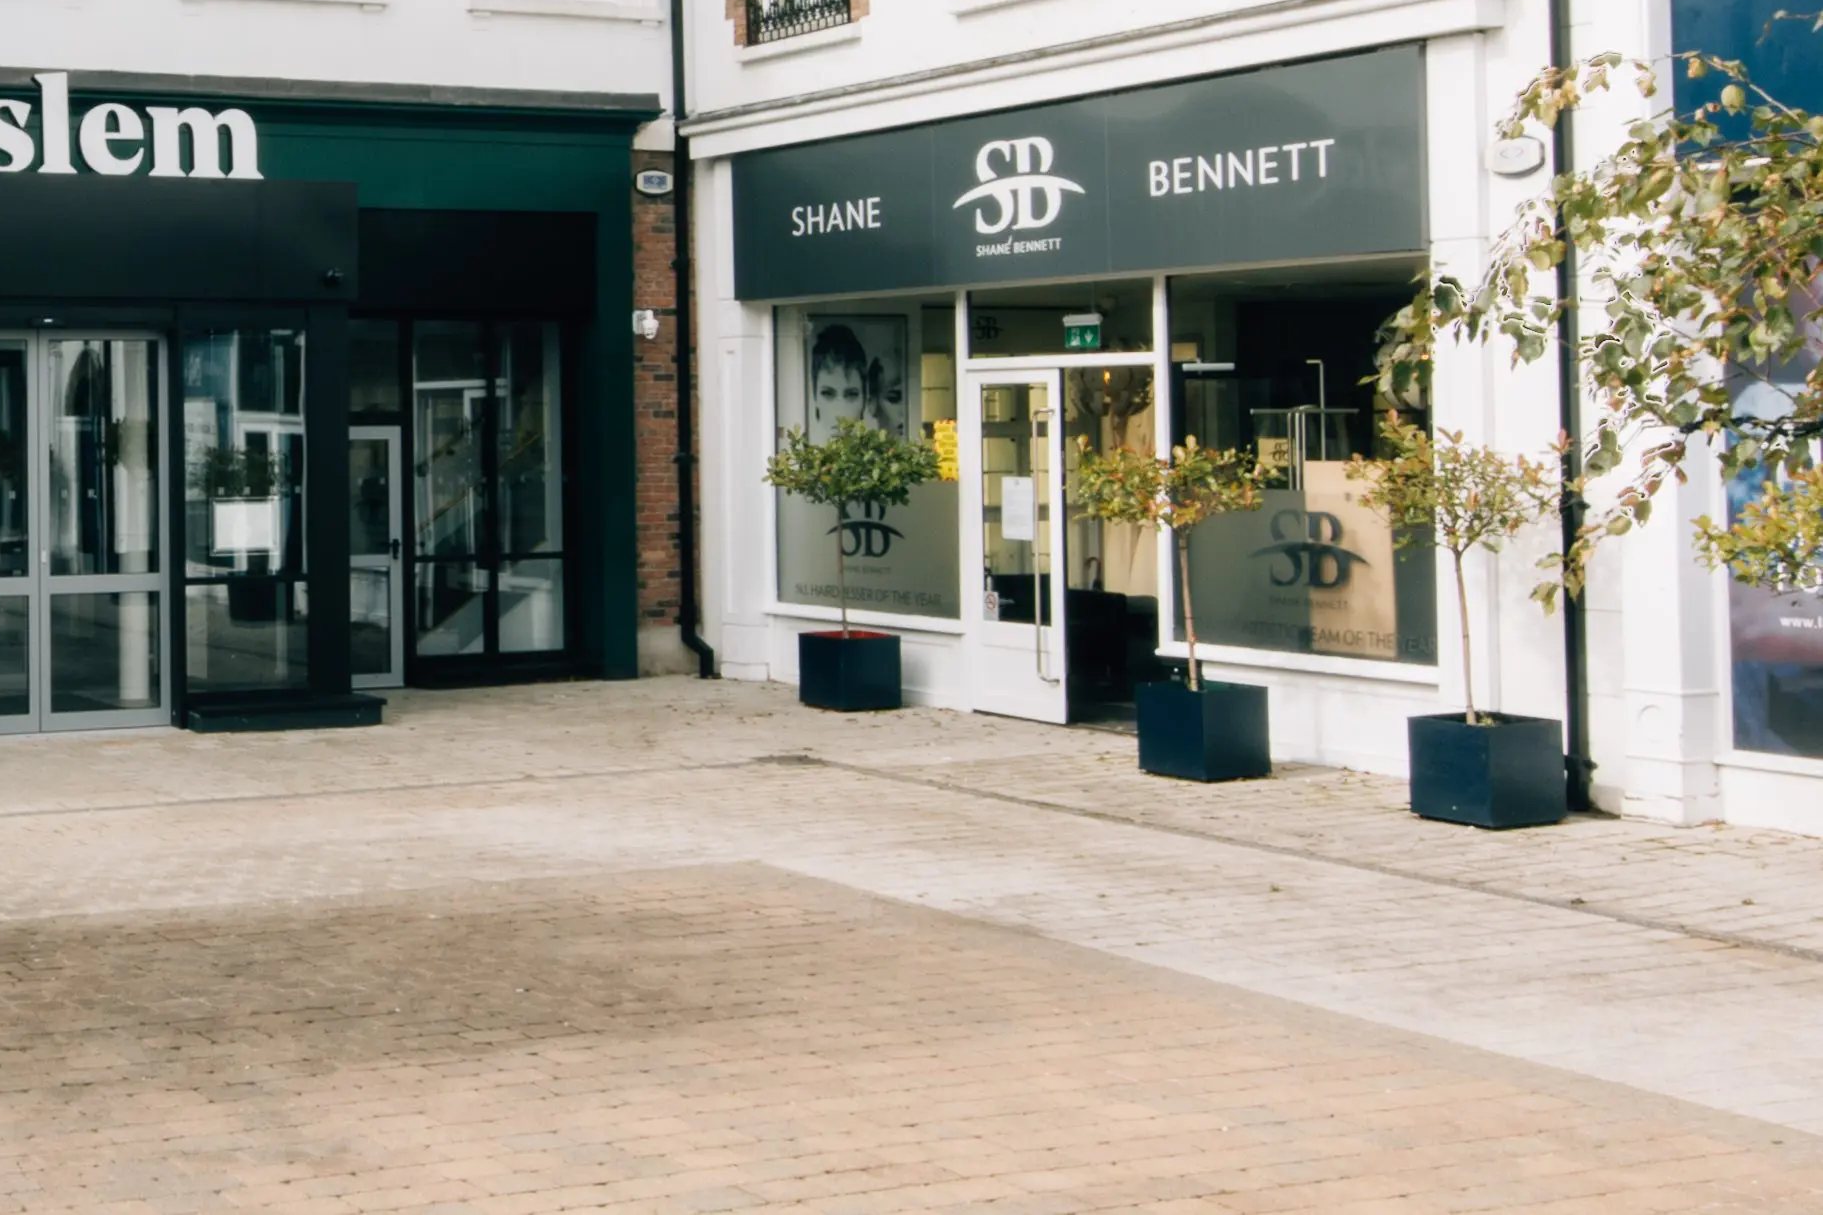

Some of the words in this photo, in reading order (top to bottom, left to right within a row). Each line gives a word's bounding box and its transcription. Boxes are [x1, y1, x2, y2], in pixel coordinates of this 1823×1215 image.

[1149, 138, 1335, 197] BENNETT
[792, 196, 881, 237] SHANE
[1013, 237, 1062, 254] BENNETT
[1343, 629, 1364, 646] OF
[1368, 631, 1394, 651] THE
